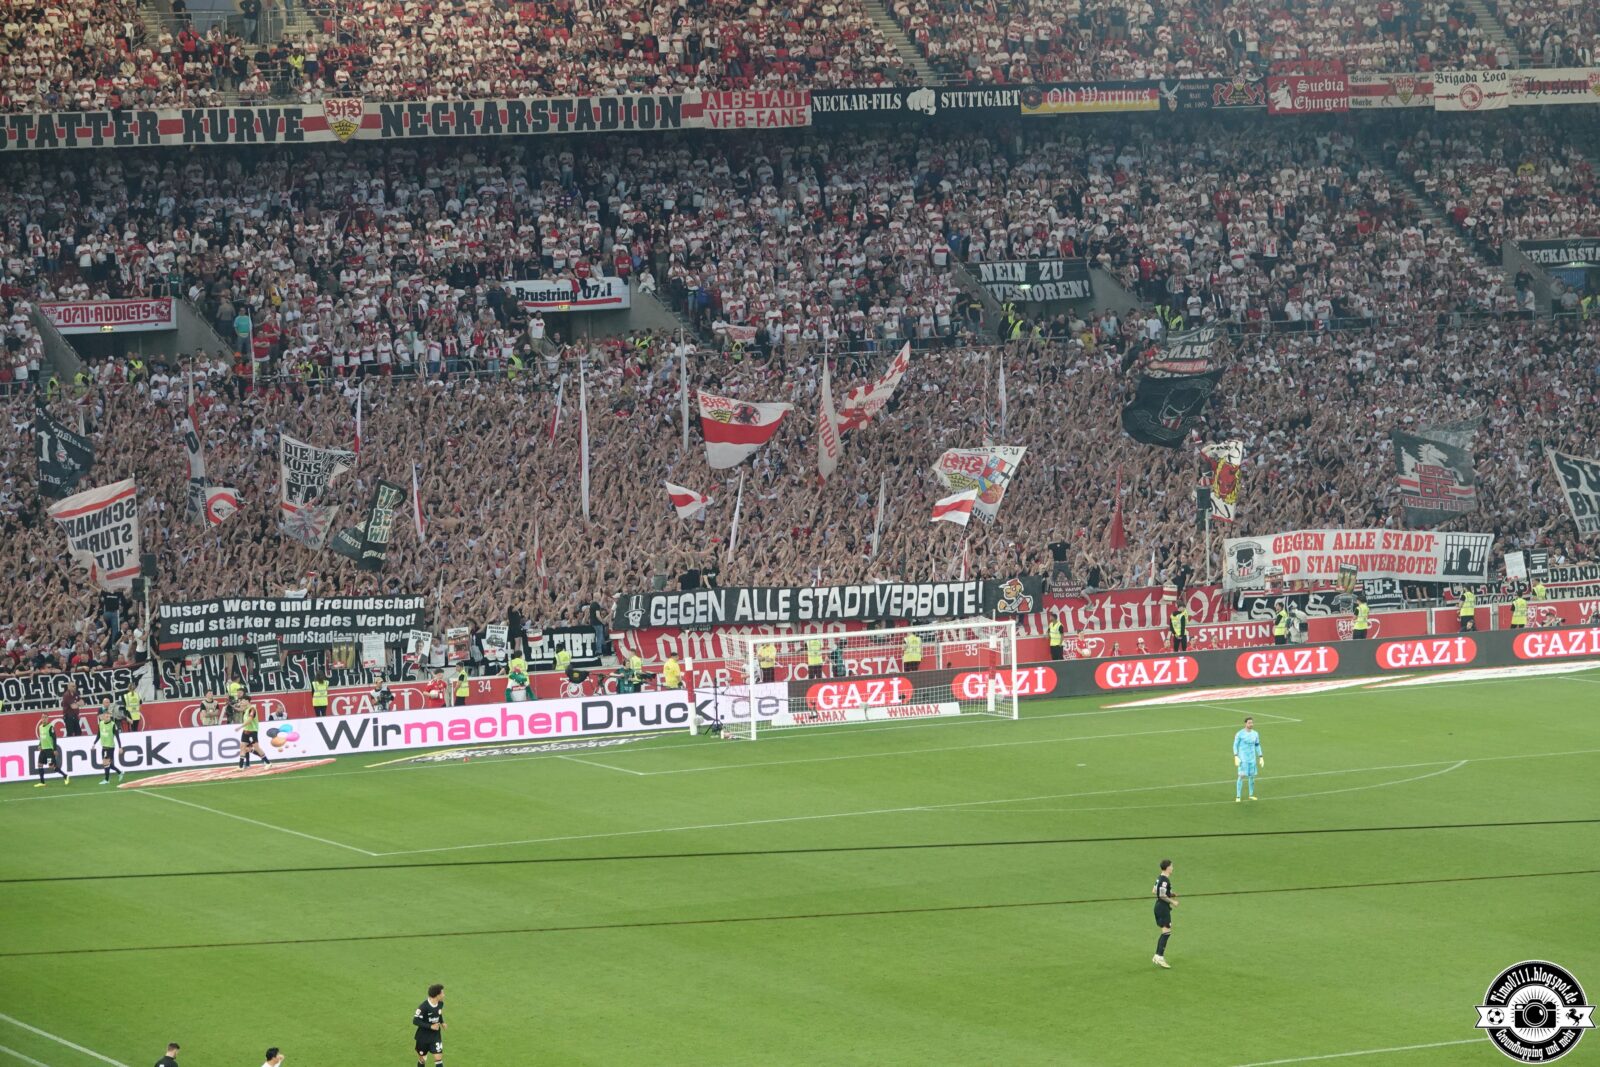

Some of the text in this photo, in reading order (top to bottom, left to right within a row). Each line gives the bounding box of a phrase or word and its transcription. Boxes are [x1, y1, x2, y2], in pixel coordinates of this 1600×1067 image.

[1297, 78, 1344, 93] Suebia
[1435, 71, 1507, 86] Brigada Loca
[706, 89, 811, 110] ALBSTADT
[813, 92, 901, 113] NECKAR-FILS
[940, 89, 1021, 109] STUTTGART
[1047, 87, 1076, 107] Old
[1080, 86, 1150, 106] Warriors
[182, 108, 304, 144] KURVE
[380, 95, 683, 138] NECKARSTADION
[709, 107, 808, 129] VFB-FANS
[980, 261, 1063, 282] NEIN ZU
[516, 287, 577, 303] Brustring
[63, 306, 90, 324] 0711
[94, 303, 151, 321] ADDICTS
[283, 441, 309, 461] DIE
[1272, 531, 1440, 555] GEGEN ALLE STADT-
[1307, 553, 1438, 575] STADIONVERBOTE!
[1542, 565, 1600, 583] DBAND
[1364, 578, 1403, 595] 50+1
[160, 596, 425, 619] Unsere Werte und Freundschaft
[650, 581, 984, 627] GEGEN ALLE STADTVERBOTE!
[169, 613, 416, 635] sind stärker als jedes Verbot!
[1160, 623, 1273, 643] V-STIFTUN
[182, 636, 218, 650] Gegen
[221, 633, 244, 647] alle
[283, 630, 305, 645] und
[965, 645, 978, 656] 35
[0, 667, 132, 703] OLIGANS
[478, 680, 492, 693] 34
[793, 710, 846, 724] WINAMAX
[887, 703, 941, 717] WINAMAX
